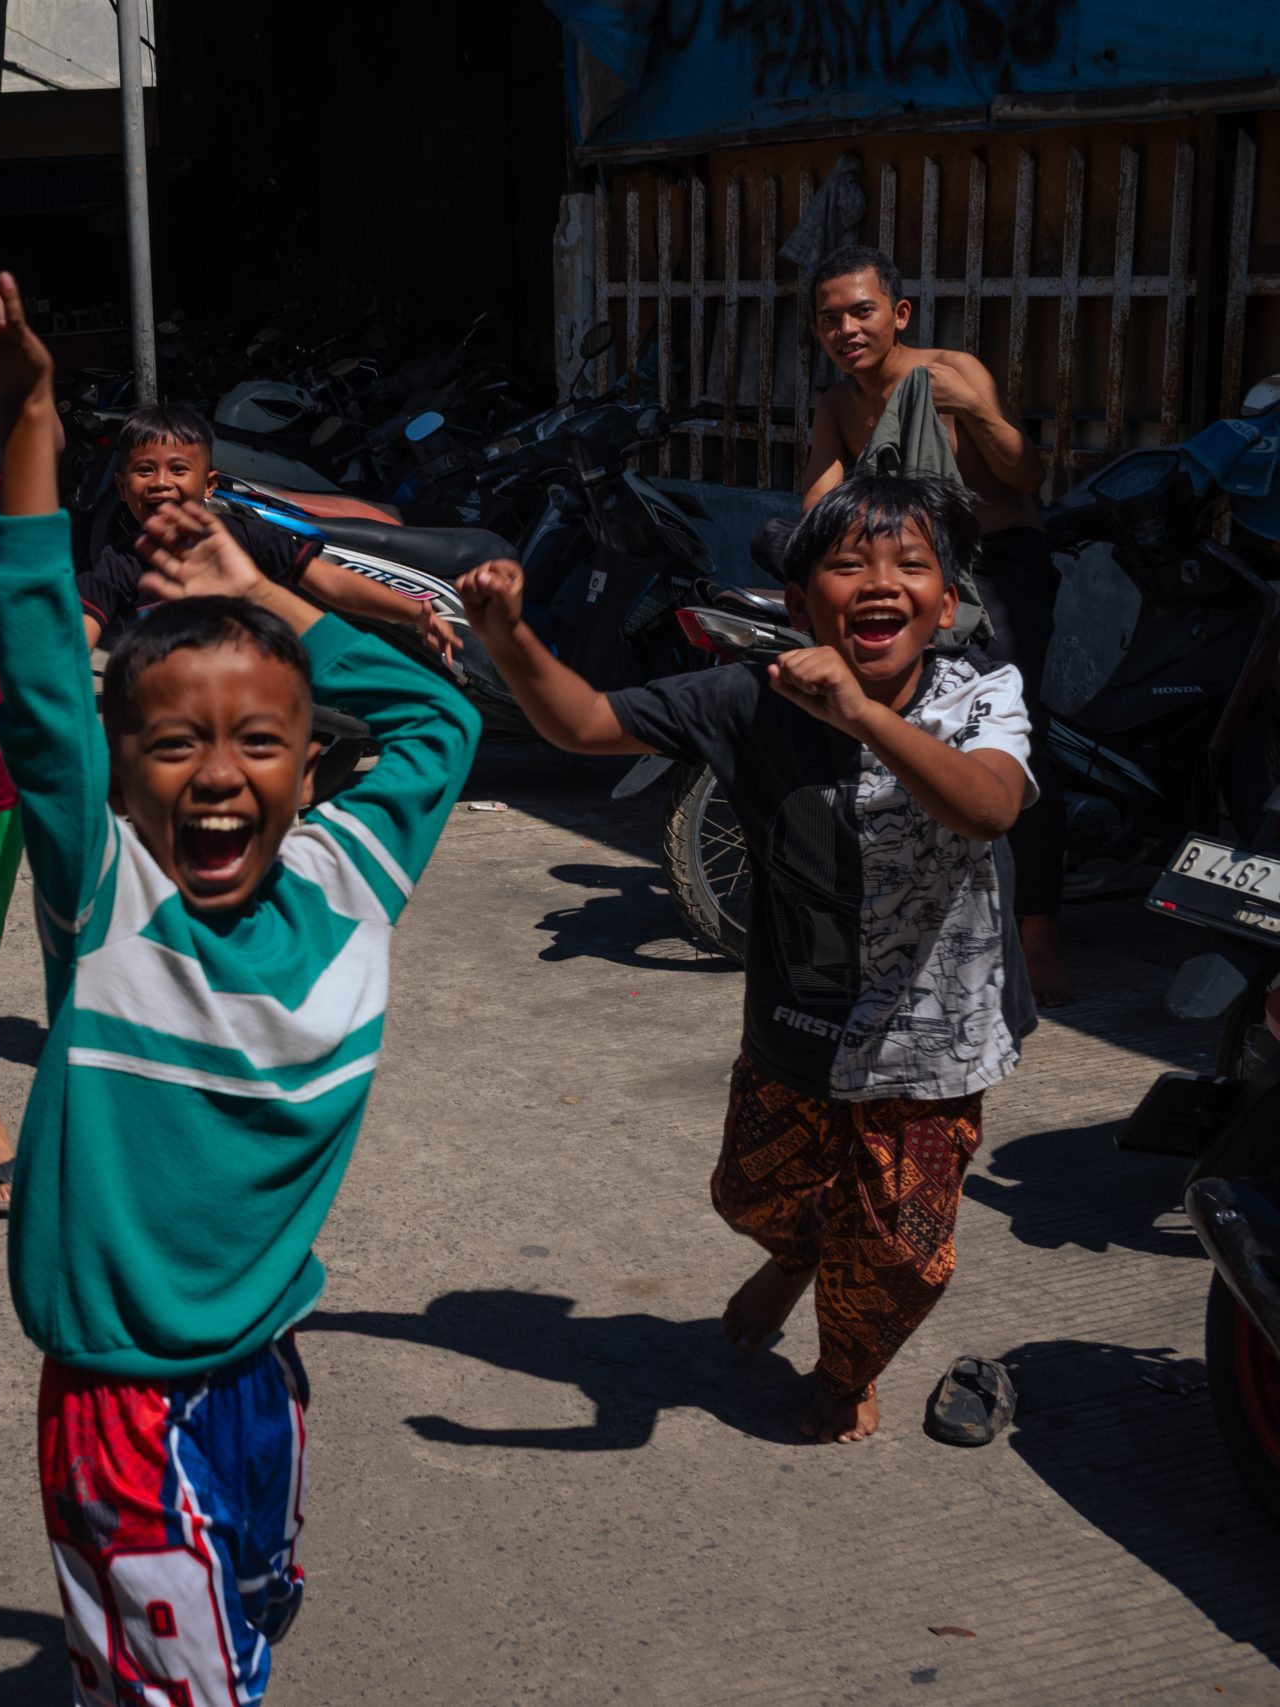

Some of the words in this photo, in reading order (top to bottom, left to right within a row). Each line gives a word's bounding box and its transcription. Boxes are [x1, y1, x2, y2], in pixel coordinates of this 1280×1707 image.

[1152, 685, 1203, 695] HONDA
[1179, 846, 1201, 873] B
[1204, 854, 1272, 894] 4462
[772, 1004, 843, 1041] FIRST
